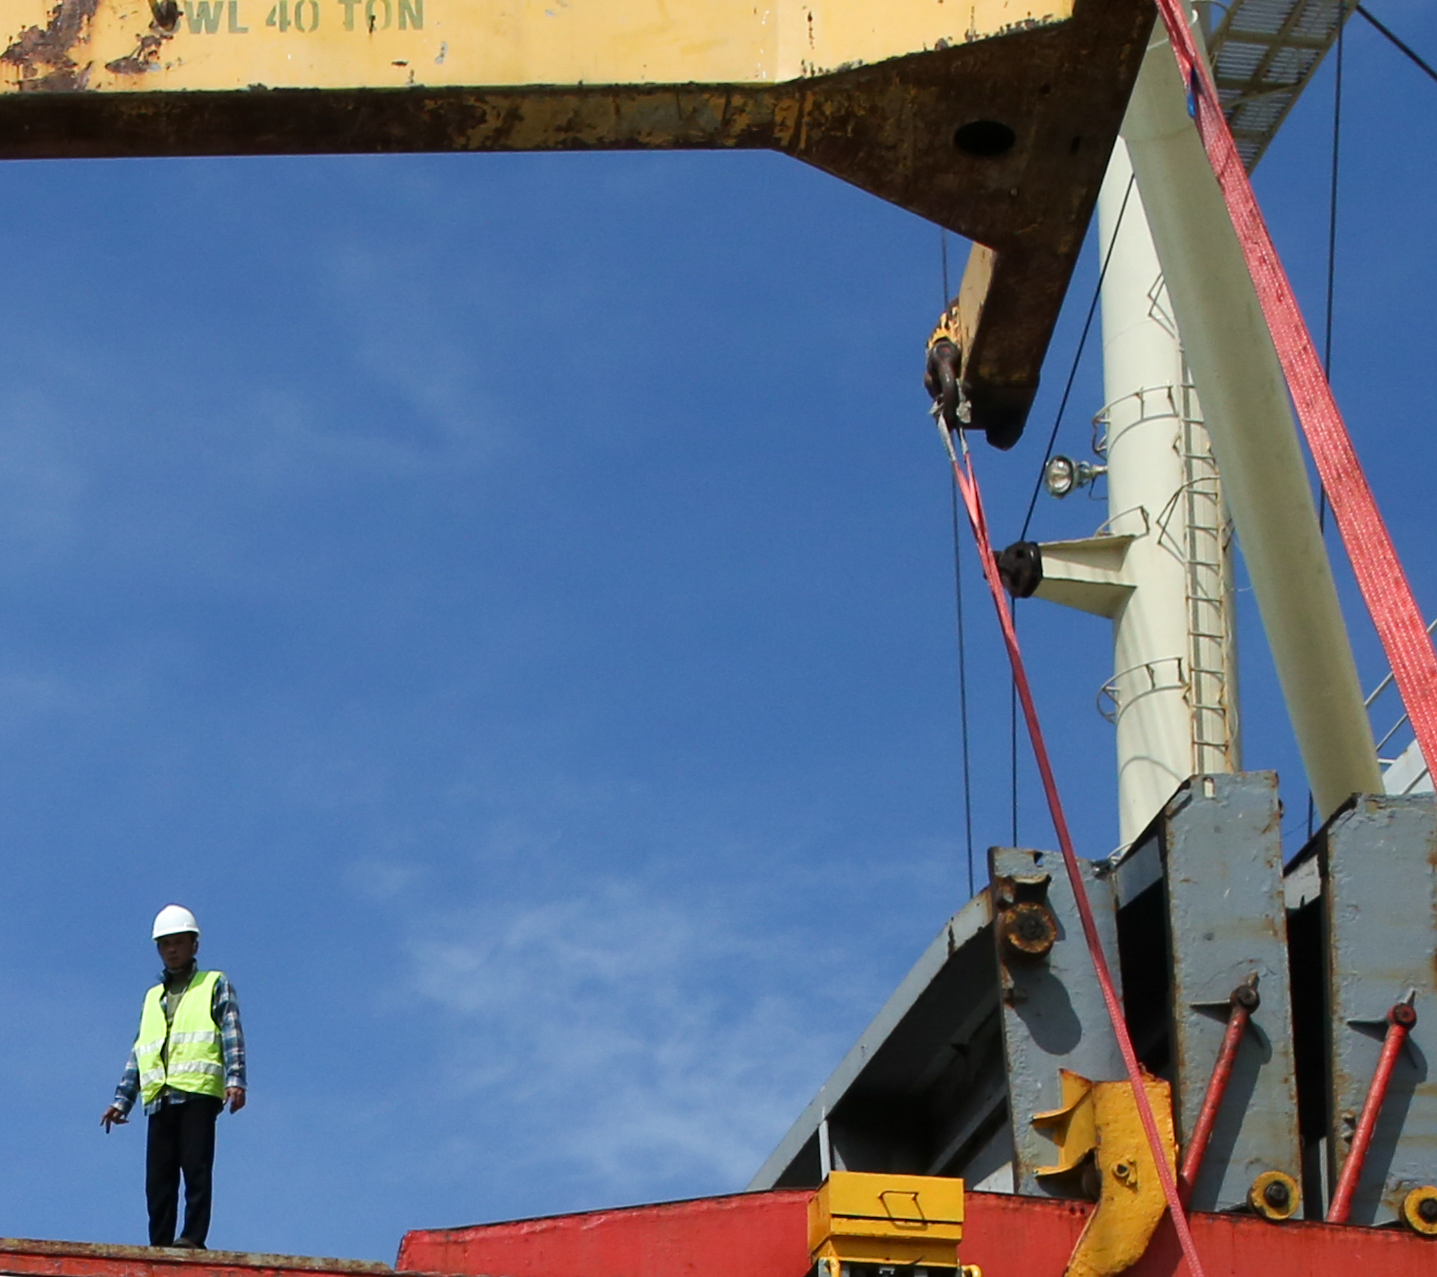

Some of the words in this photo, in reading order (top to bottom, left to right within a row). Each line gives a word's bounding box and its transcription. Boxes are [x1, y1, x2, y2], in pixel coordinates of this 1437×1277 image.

[161, 0, 249, 35] WL
[265, 0, 320, 33] 40
[338, 0, 424, 31] TON
